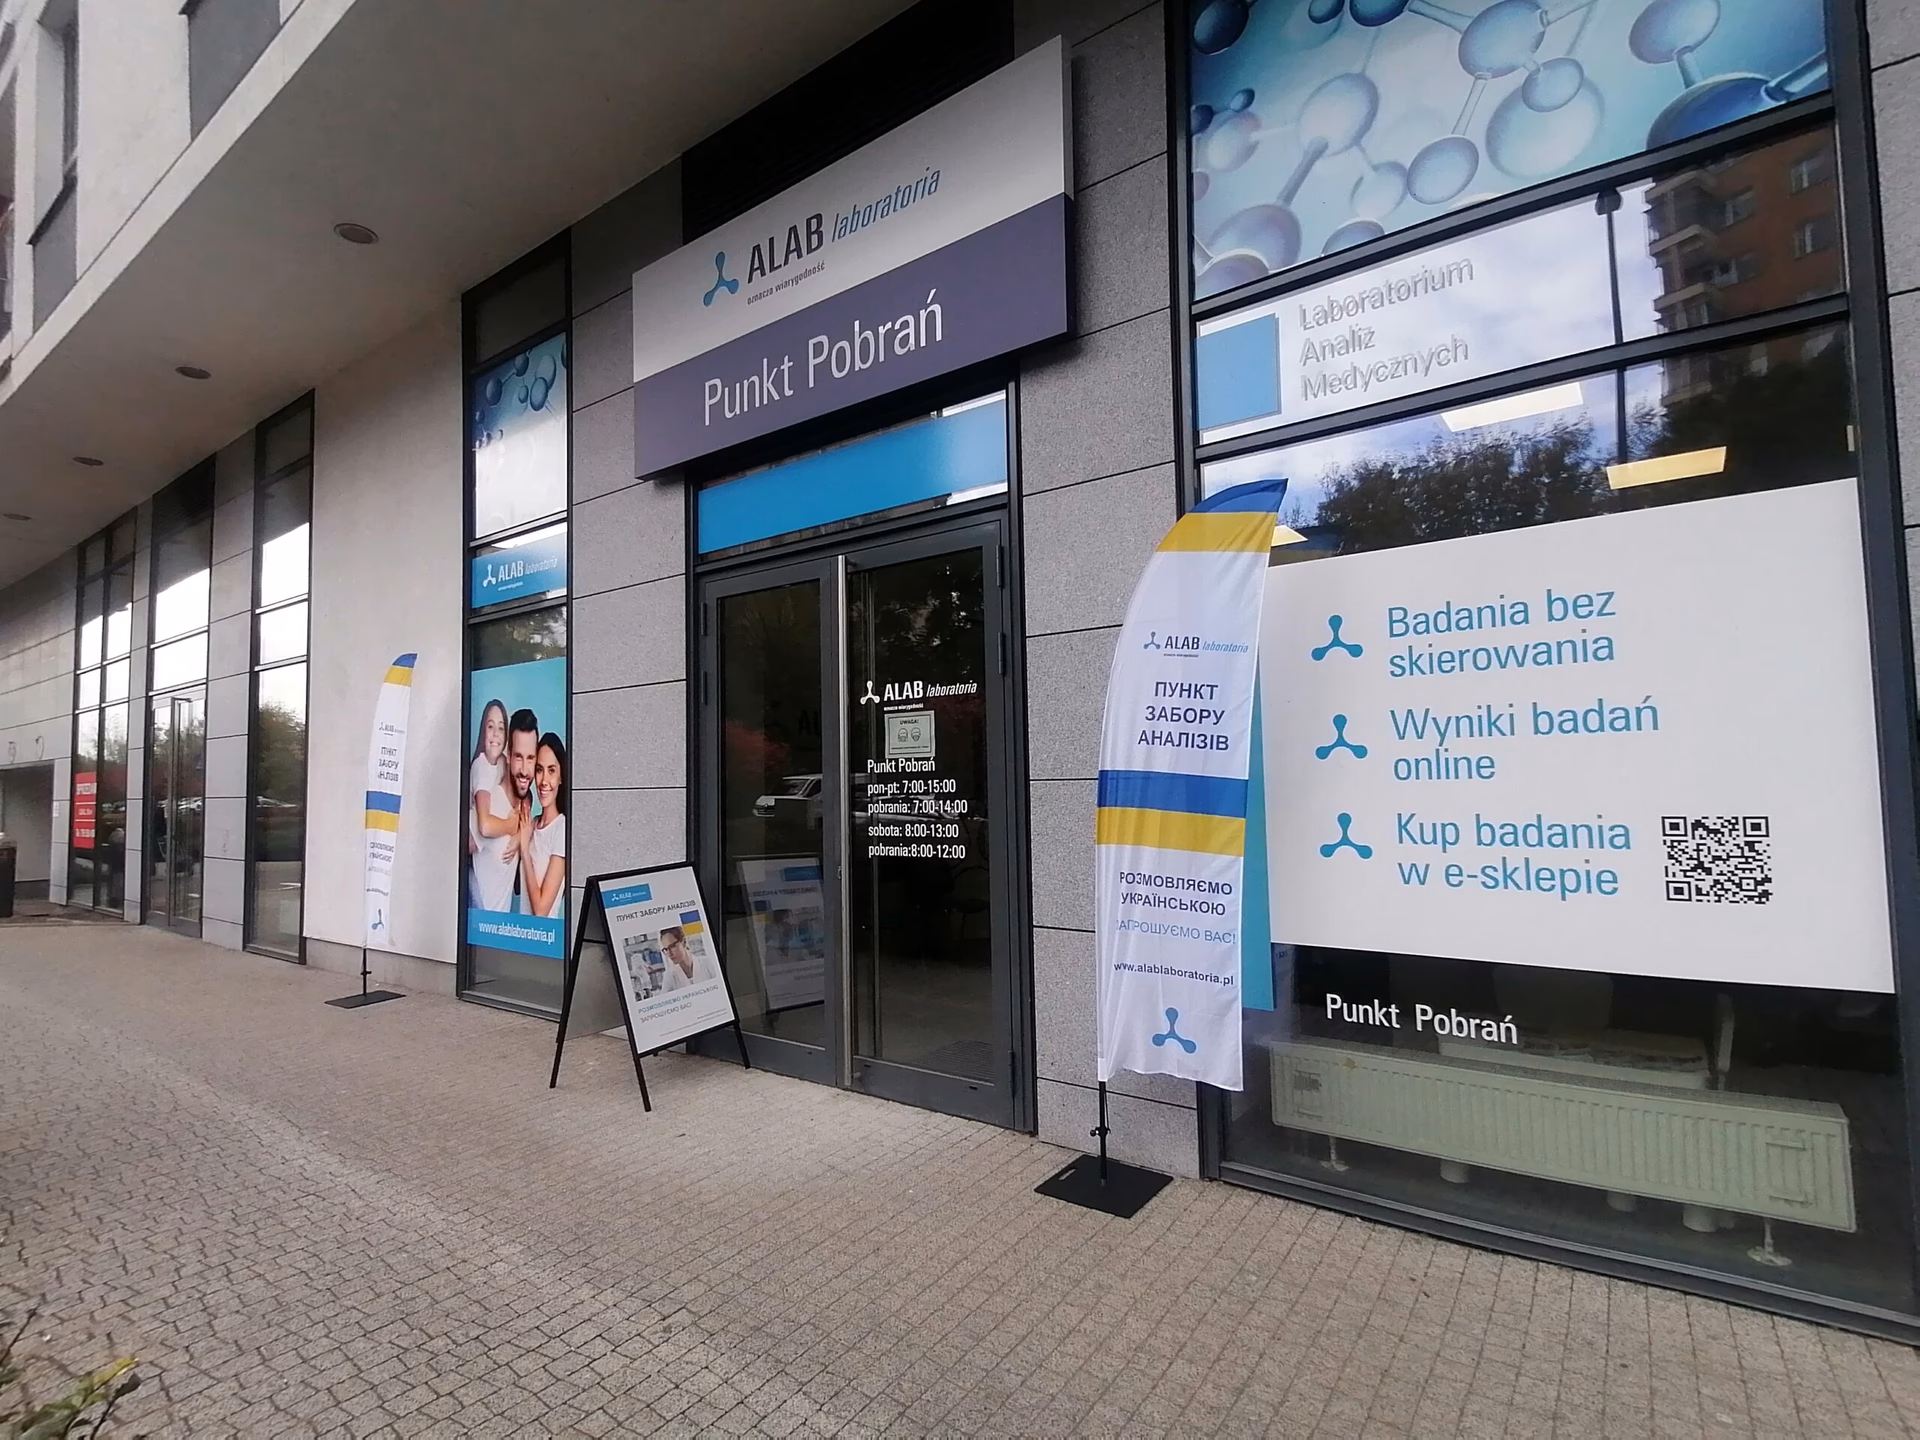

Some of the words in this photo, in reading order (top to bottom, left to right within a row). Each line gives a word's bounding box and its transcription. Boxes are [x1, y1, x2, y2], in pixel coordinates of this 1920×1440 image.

[747, 212, 824, 284] ALAB
[832, 166, 941, 243] laboratoria
[775, 260, 825, 292] wiarygodność
[1299, 257, 1474, 331] Laboratorium
[704, 355, 794, 426] Punkt
[808, 288, 942, 388] Pobrań
[1299, 323, 1376, 367] Analiz
[1301, 334, 1469, 401] Medycznych
[498, 560, 523, 582] ALAB
[1387, 594, 1530, 638] Badania
[1546, 588, 1617, 623] bez
[1164, 635, 1200, 650] ALAB
[1202, 640, 1249, 654] laboratoria
[1388, 628, 1616, 678] skierowania
[883, 680, 924, 702] ALAB
[926, 680, 978, 698] laboratoria
[1154, 681, 1219, 700] ПУНКТ
[1145, 705, 1225, 726] ЗАБОРУ
[1389, 703, 1516, 747] Wyniki
[1531, 695, 1660, 736] badań
[1137, 729, 1230, 751] АНАЛІЗІВ
[867, 759, 896, 774] Punkt
[898, 756, 935, 773] Pobrań
[1393, 748, 1496, 781] online
[867, 781, 900, 797] pon-pt:
[902, 779, 956, 794] 7:00-15:00
[867, 800, 911, 817] pobrania:
[913, 799, 968, 814] 7:00-14:00
[868, 823, 902, 837] sobota:
[905, 823, 959, 838] 8:00-13:00
[1396, 812, 1460, 853] Kup
[1475, 813, 1631, 851] badania
[1119, 871, 1233, 896] РОЗМОВЛЯЄМО
[1396, 861, 1430, 886] w
[1444, 857, 1619, 901] e-sklepie
[616, 911, 638, 922] ПУНКТ
[640, 906, 666, 918] ЗАБОРУ
[667, 900, 696, 911] АНАЛІЗІВ
[1121, 891, 1226, 916] УКРАЇНСЬКОЮ
[478, 922, 555, 945] www.alablaboratoria.pl
[1204, 929, 1236, 945] ВАС!
[1113, 962, 1234, 987] www.alablaboratoria.pl
[1325, 993, 1400, 1029] Punkt
[1415, 1003, 1518, 1044] Pobrań
